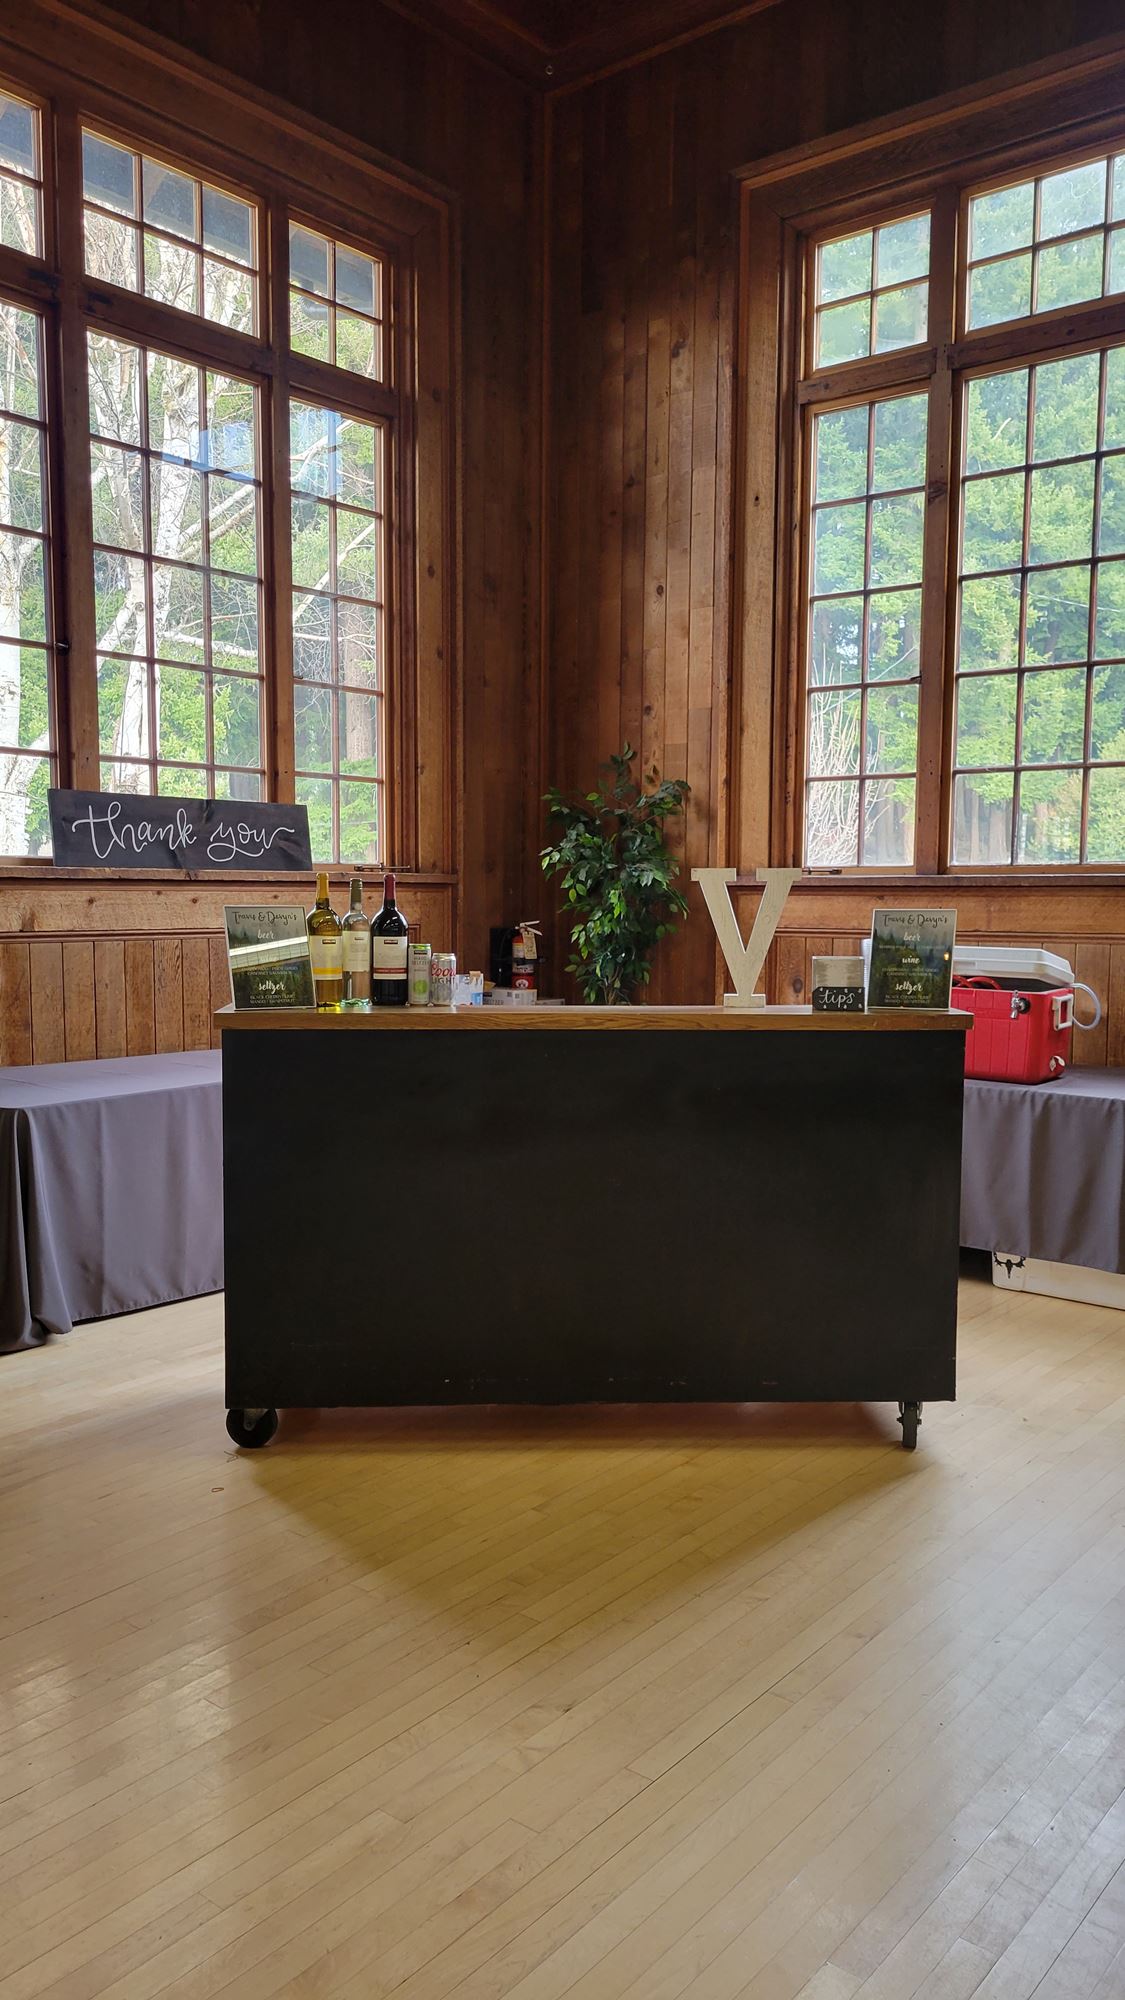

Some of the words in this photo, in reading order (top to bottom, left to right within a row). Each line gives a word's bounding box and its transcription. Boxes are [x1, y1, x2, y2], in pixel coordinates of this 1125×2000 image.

[72, 801, 197, 859] thank
[207, 821, 295, 862] you
[258, 911, 265, 922] &
[907, 914, 915, 925] &
[257, 929, 275, 940] beer
[690, 867, 802, 1008] V
[903, 931, 921, 942] beer
[902, 955, 920, 964] wine
[818, 989, 855, 1008] tips
